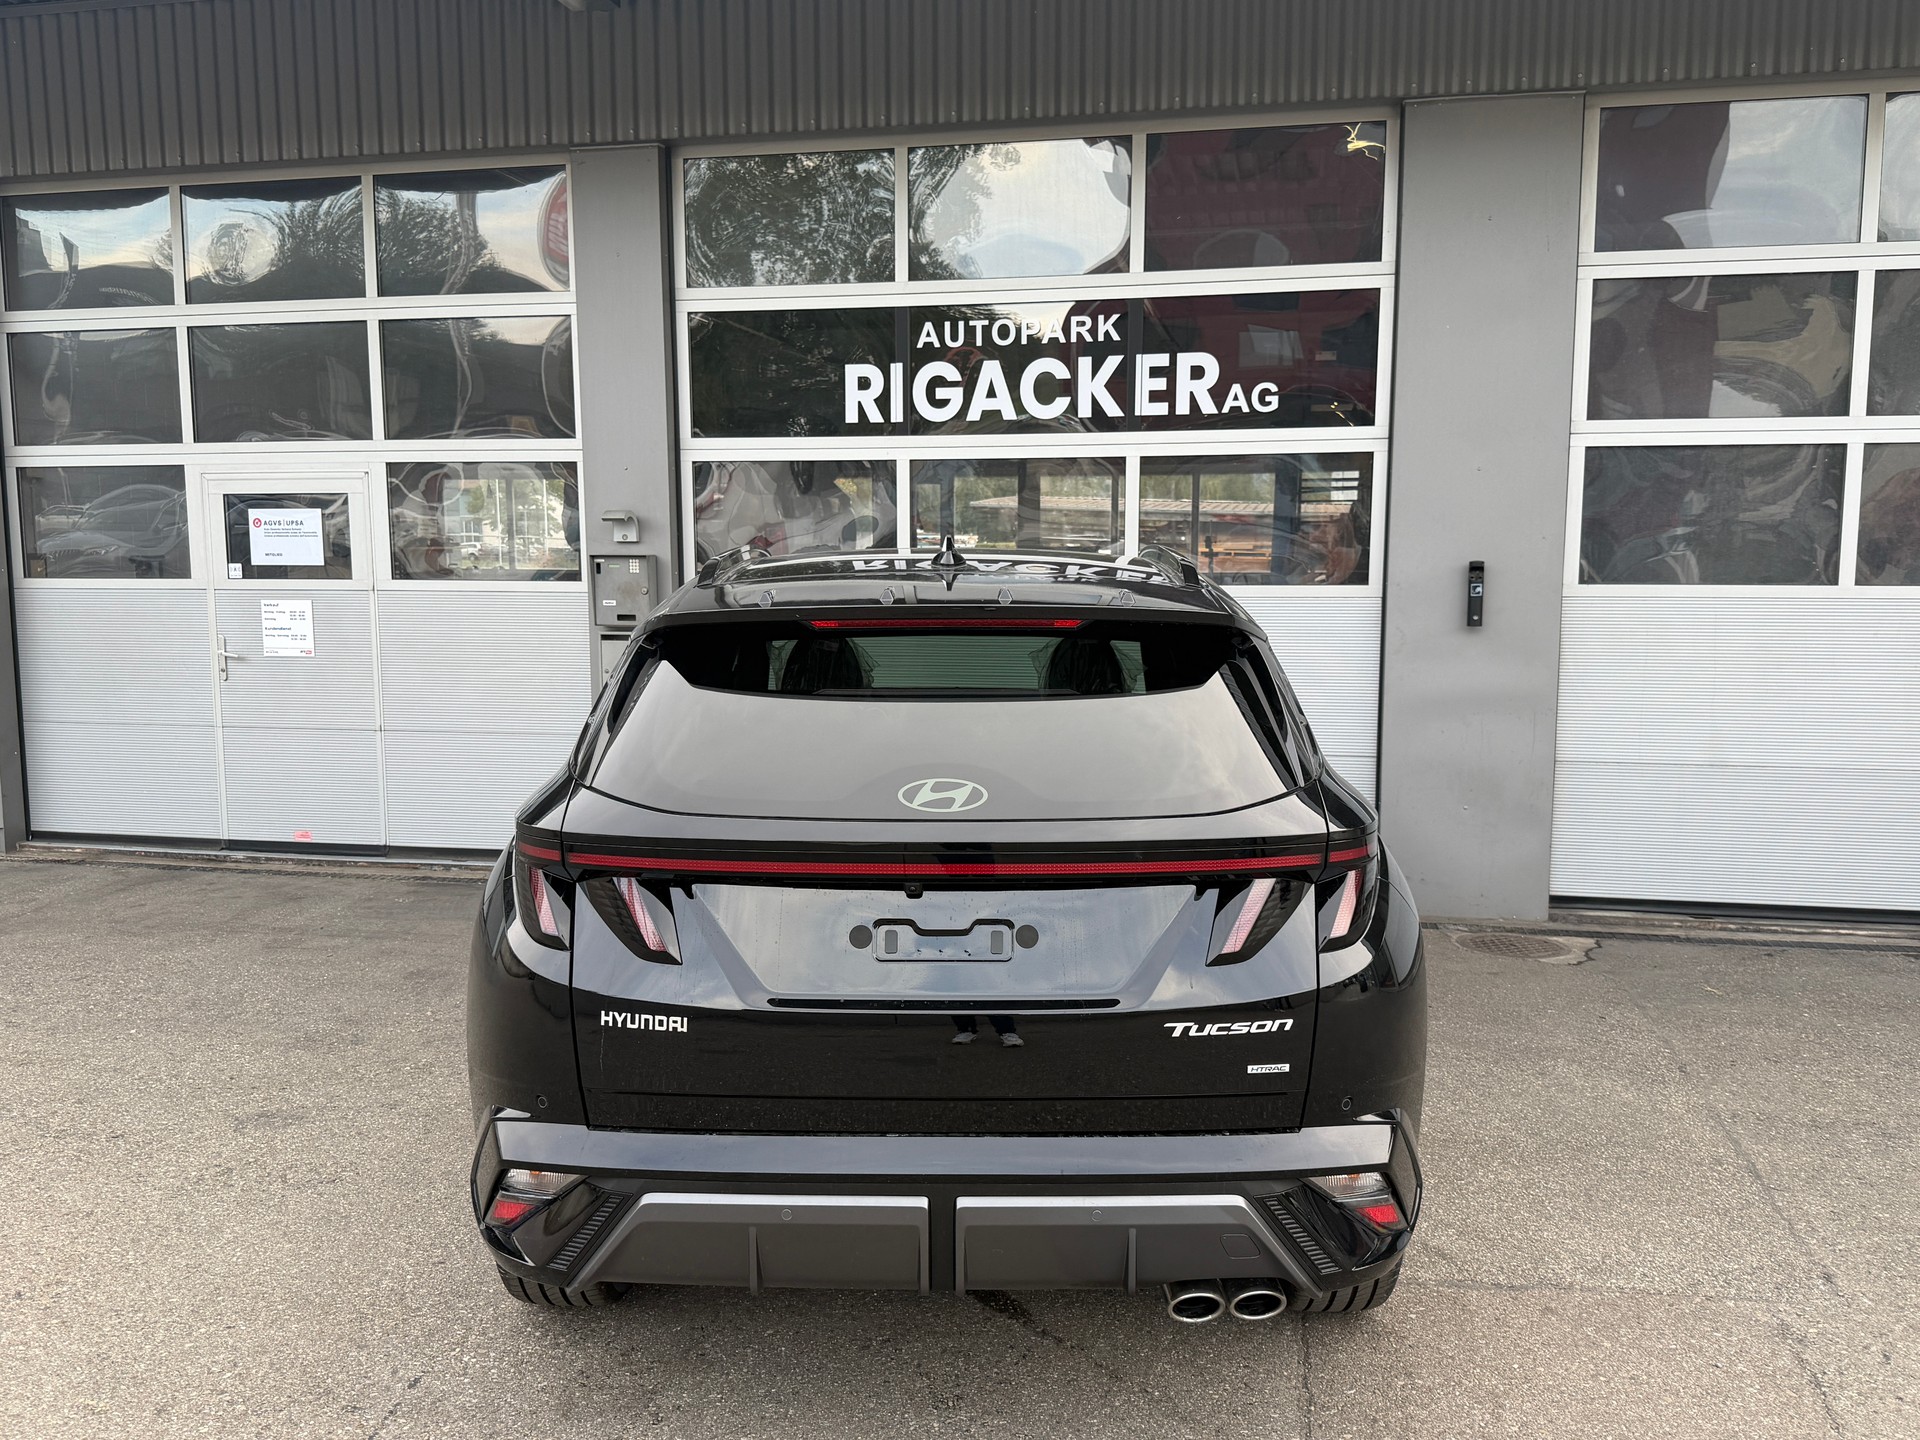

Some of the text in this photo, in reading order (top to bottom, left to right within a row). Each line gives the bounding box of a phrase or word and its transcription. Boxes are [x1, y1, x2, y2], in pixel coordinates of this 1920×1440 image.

[916, 313, 1122, 349] AUTOPARK
[843, 351, 1280, 424] RIGACKER AG
[285, 519, 304, 527] UPSA
[600, 1010, 688, 1033] HYUNDAI
[1250, 1065, 1287, 1073] HTRAC
